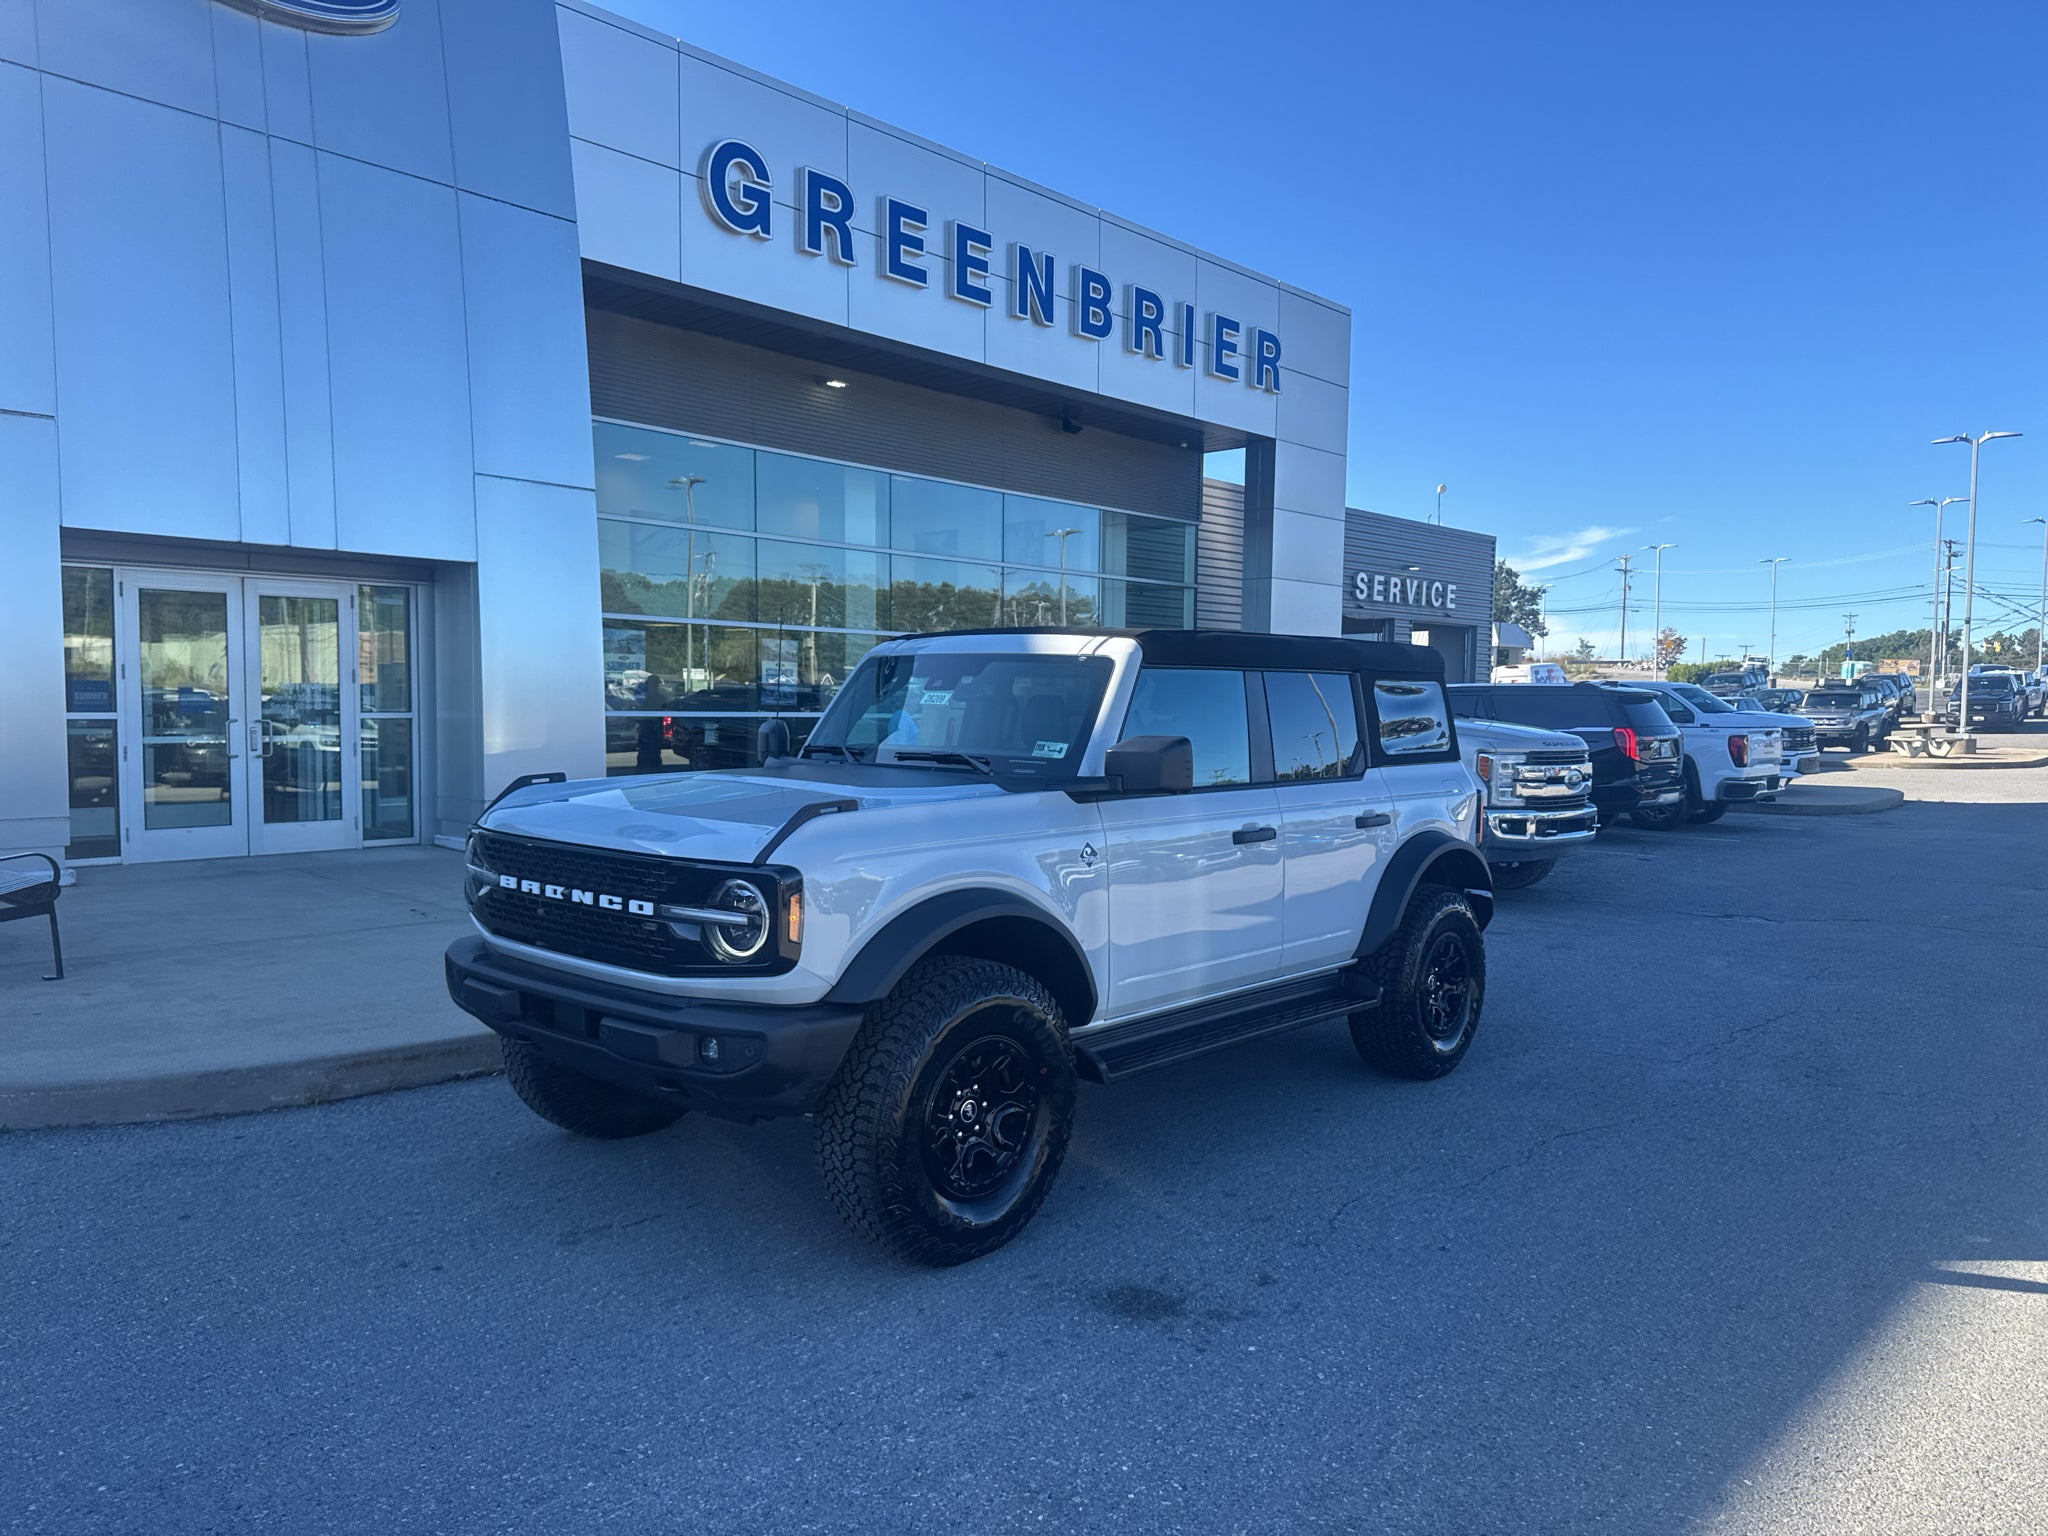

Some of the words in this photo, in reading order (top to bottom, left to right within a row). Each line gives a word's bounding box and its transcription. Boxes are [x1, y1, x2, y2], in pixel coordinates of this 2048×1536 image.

[701, 138, 1282, 394] GREENBRIER
[1355, 571, 1457, 609] SERVICE
[499, 874, 654, 916] BRONCO
